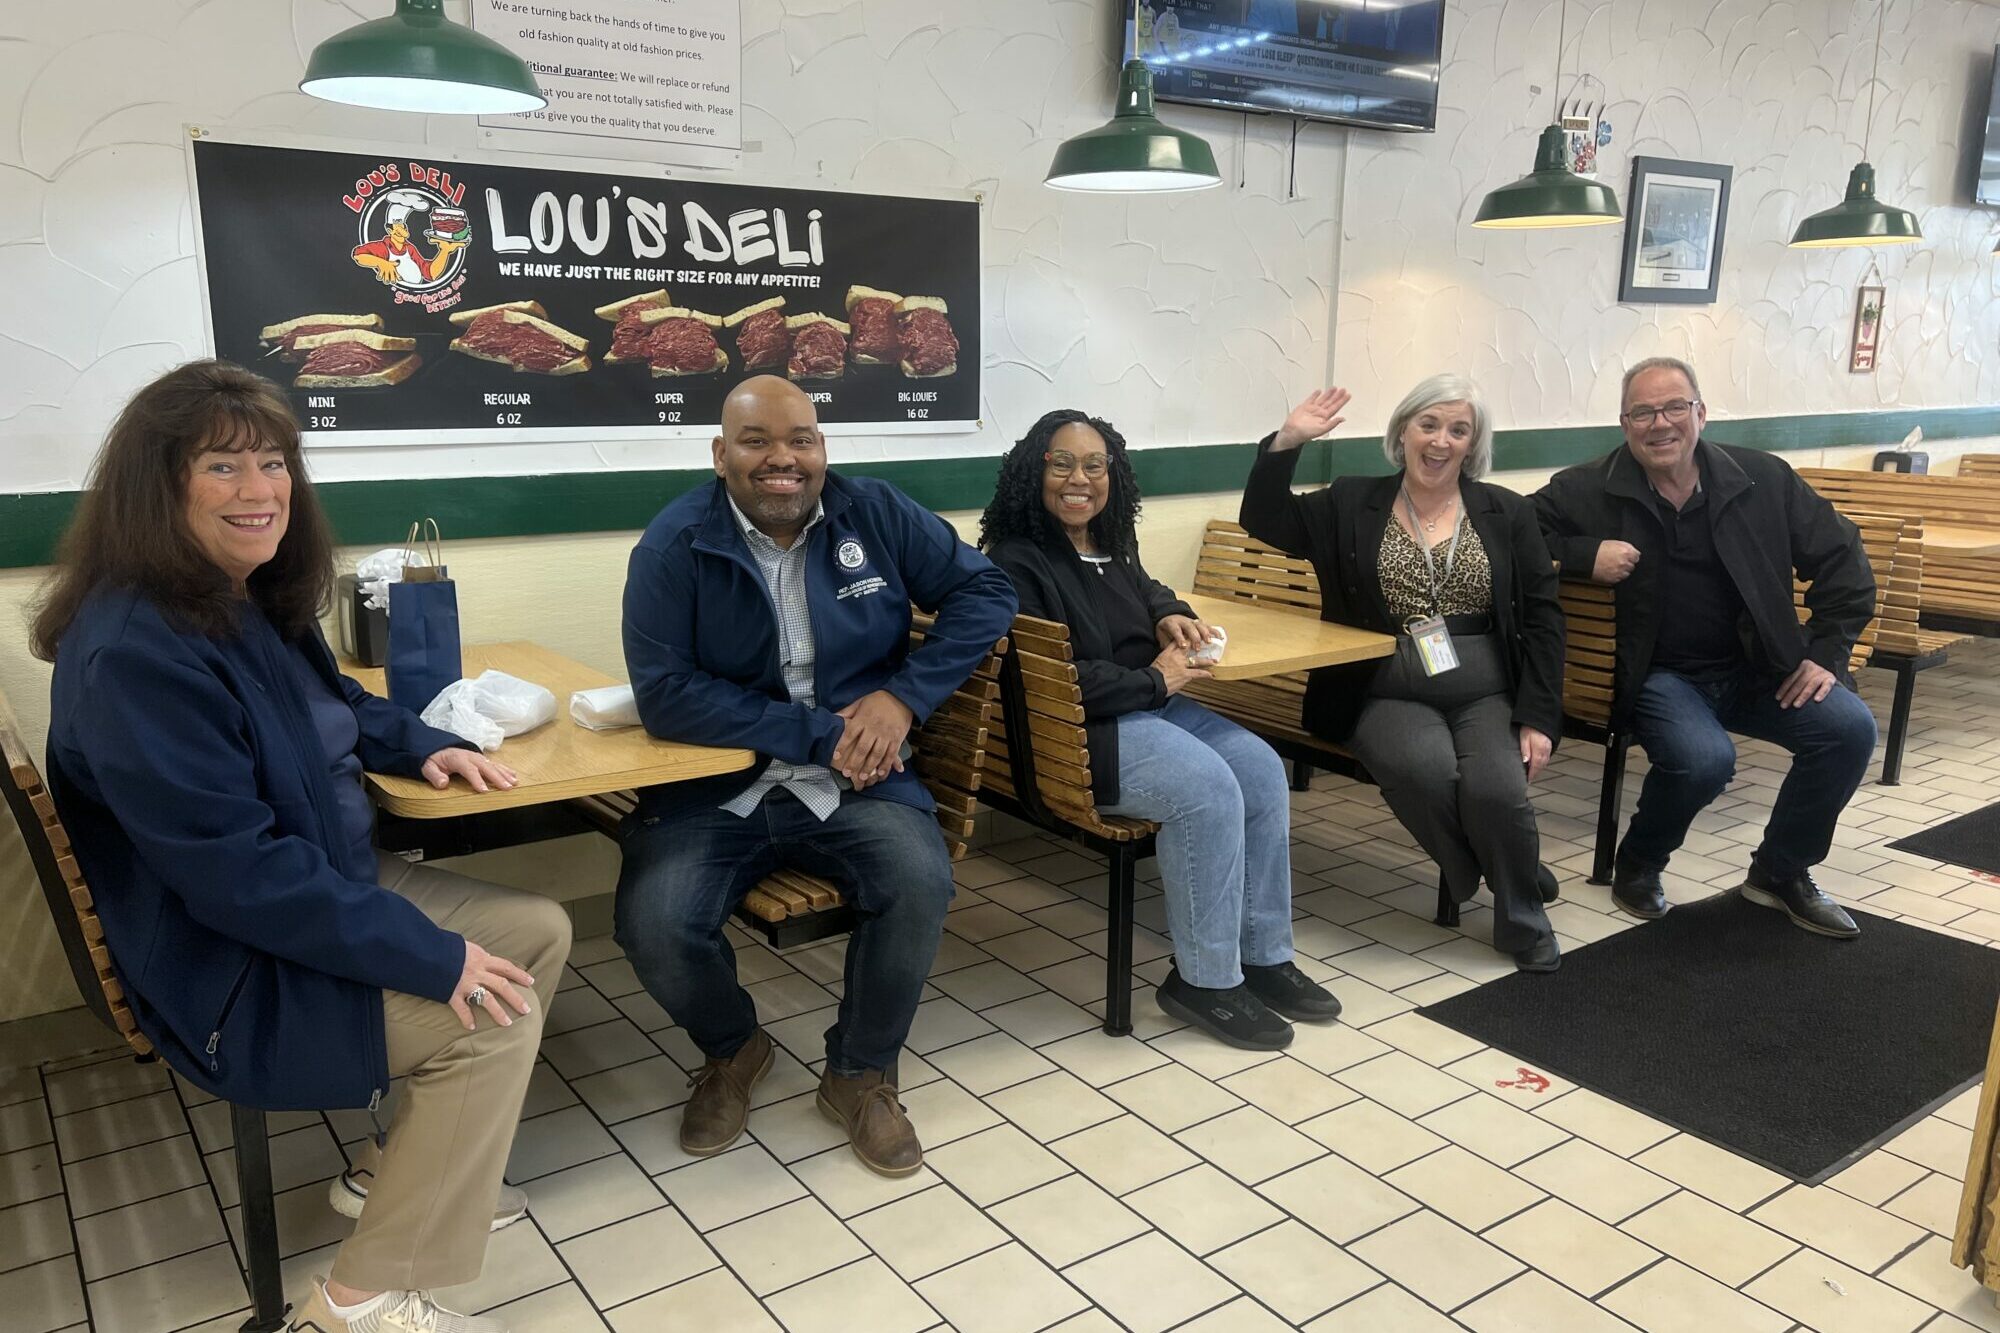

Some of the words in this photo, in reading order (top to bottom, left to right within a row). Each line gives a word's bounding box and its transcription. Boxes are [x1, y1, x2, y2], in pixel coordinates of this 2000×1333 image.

[491, 0, 509, 11] We
[511, 5, 528, 14] are
[531, 6, 567, 20] turning
[570, 10, 592, 22] back
[594, 15, 610, 25] the
[613, 16, 640, 29] hands
[642, 21, 652, 30] of
[655, 23, 675, 34] time
[678, 27, 687, 36] to
[690, 28, 707, 38] give
[710, 32, 725, 41] you
[519, 29, 535, 39] old
[538, 30, 574, 43] fashion
[577, 37, 609, 50] quality
[611, 41, 620, 50] at
[623, 42, 637, 52] old
[640, 44, 673, 56] fashion
[676, 49, 704, 60] prices.
[527, 61, 561, 75] itional
[564, 66, 618, 81] guarantee:
[620, 72, 636, 81] We
[638, 74, 654, 84] will
[656, 77, 688, 88] replace
[691, 81, 700, 90] or
[702, 82, 730, 93] refund
[556, 90, 574, 99] you
[577, 91, 592, 101] are
[595, 93, 611, 103] not
[613, 95, 643, 106] totally
[645, 98, 682, 110] satisfied
[684, 102, 706, 112] with.
[707, 104, 734, 116] Please
[534, 111, 545, 120] us
[548, 111, 568, 122] give
[570, 114, 588, 123] you
[591, 114, 606, 125] the
[609, 118, 640, 129] quality
[642, 119, 661, 130] that
[663, 123, 680, 132] you
[343, 163, 401, 213] LOU'S
[409, 162, 466, 207] DELI
[486, 186, 668, 259] LOU'S
[499, 262, 521, 276] WE
[523, 263, 562, 278] HAVE
[564, 265, 602, 279] JUST
[603, 267, 631, 281] THE
[634, 268, 675, 282] RIGHT
[676, 270, 706, 284] SIZE
[708, 271, 732, 285] FOR
[734, 272, 759, 286] ANY
[761, 274, 821, 288] APPETITE!
[308, 396, 336, 408] MINI
[483, 393, 531, 405] REGULAR
[655, 392, 684, 404] SUPER
[898, 392, 911, 402] BIG
[912, 392, 937, 402] LOUIES
[311, 416, 319, 428] 3
[321, 416, 336, 427] OZ
[496, 414, 504, 425] 6
[507, 413, 522, 424] OZ
[658, 412, 666, 422] 9
[668, 411, 681, 422] OZ
[907, 409, 916, 419] 16
[917, 409, 929, 418] OZ
